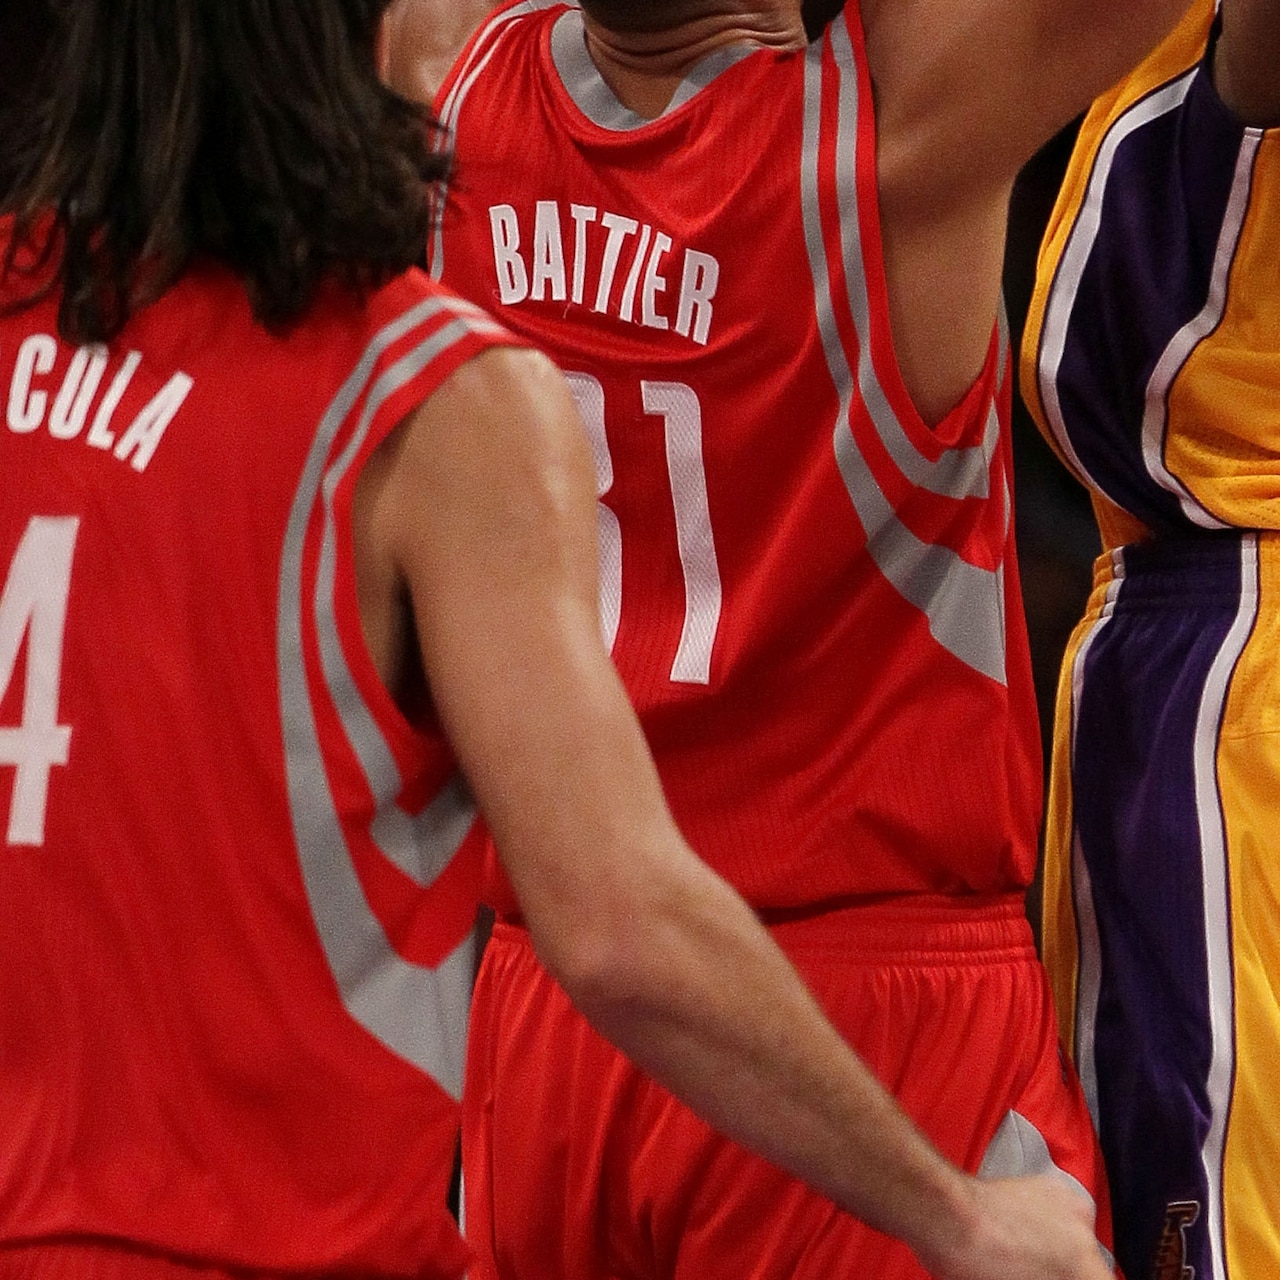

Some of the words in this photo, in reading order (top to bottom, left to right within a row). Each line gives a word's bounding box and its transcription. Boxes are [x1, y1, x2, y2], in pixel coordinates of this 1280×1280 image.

[489, 200, 720, 345] BATTIER
[6, 333, 195, 474] COLA
[0, 515, 80, 847] 4
